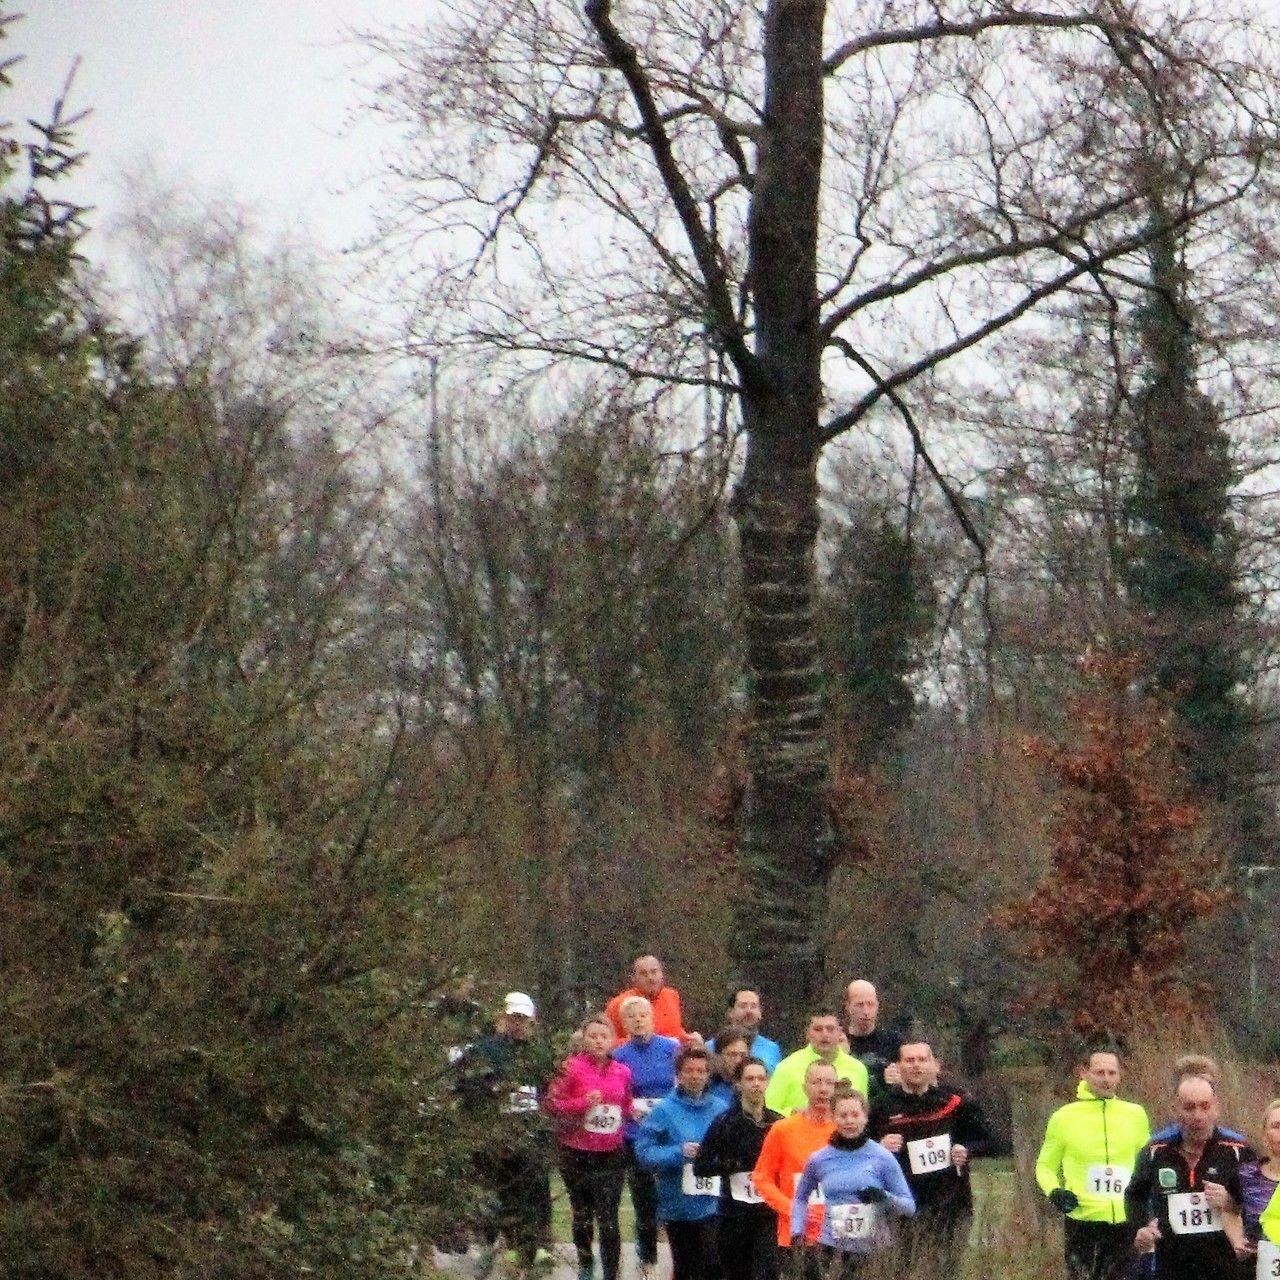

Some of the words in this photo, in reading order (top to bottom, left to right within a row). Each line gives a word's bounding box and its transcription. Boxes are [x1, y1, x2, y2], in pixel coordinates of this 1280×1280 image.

[919, 1149, 946, 1167] 109
[1094, 1178, 1122, 1194] 116
[1179, 1208, 1213, 1226] 181
